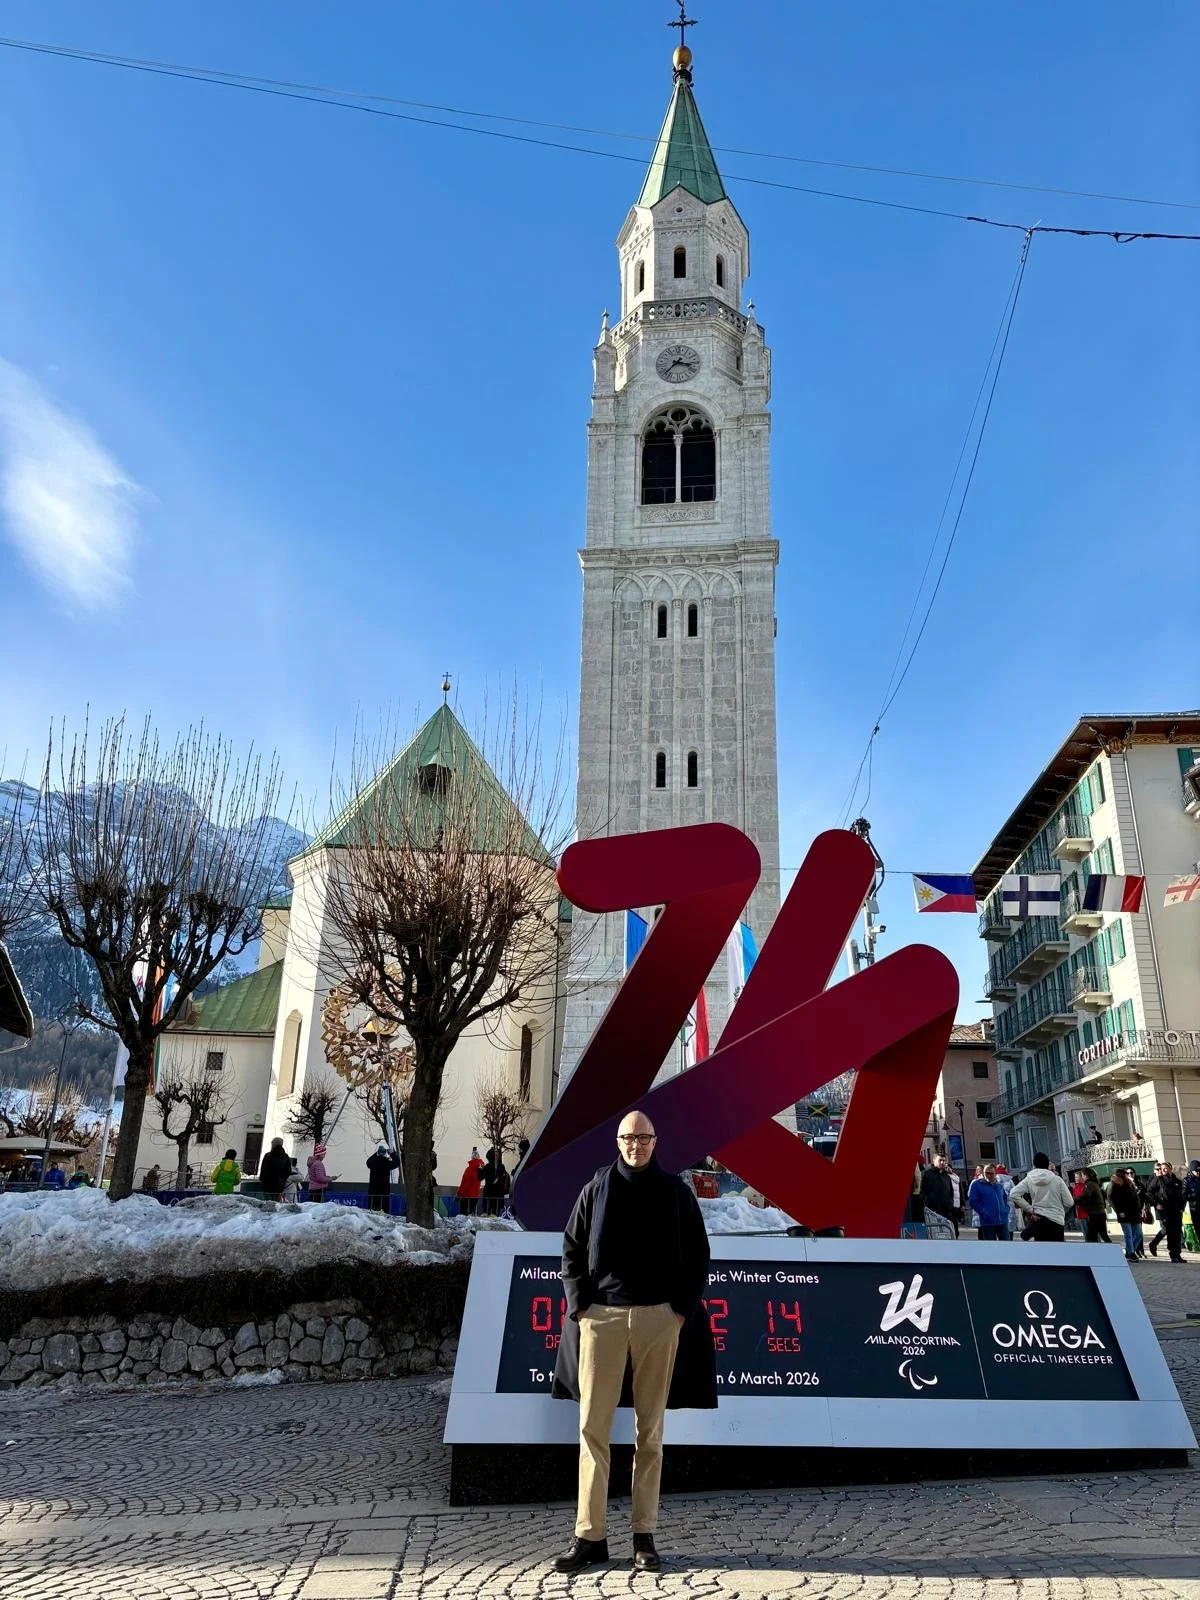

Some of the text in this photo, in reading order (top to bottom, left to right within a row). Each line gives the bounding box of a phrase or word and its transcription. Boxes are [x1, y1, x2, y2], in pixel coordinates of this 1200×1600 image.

[1078, 1033, 1121, 1066] CORTINA
[729, 1270, 772, 1282] Winter
[775, 1271, 820, 1284] Games
[767, 1300, 802, 1334] 14
[864, 1335, 961, 1346] MILANO CORTINA
[992, 1323, 1106, 1349] OMEGA
[767, 1337, 801, 1352] SECS
[902, 1346, 926, 1355] 2026
[994, 1353, 1114, 1365] OFFICIAL TIMEKEEPER
[529, 1368, 545, 1382] To
[727, 1370, 737, 1384] 6
[740, 1371, 783, 1385] March
[786, 1371, 820, 1385] 2026
